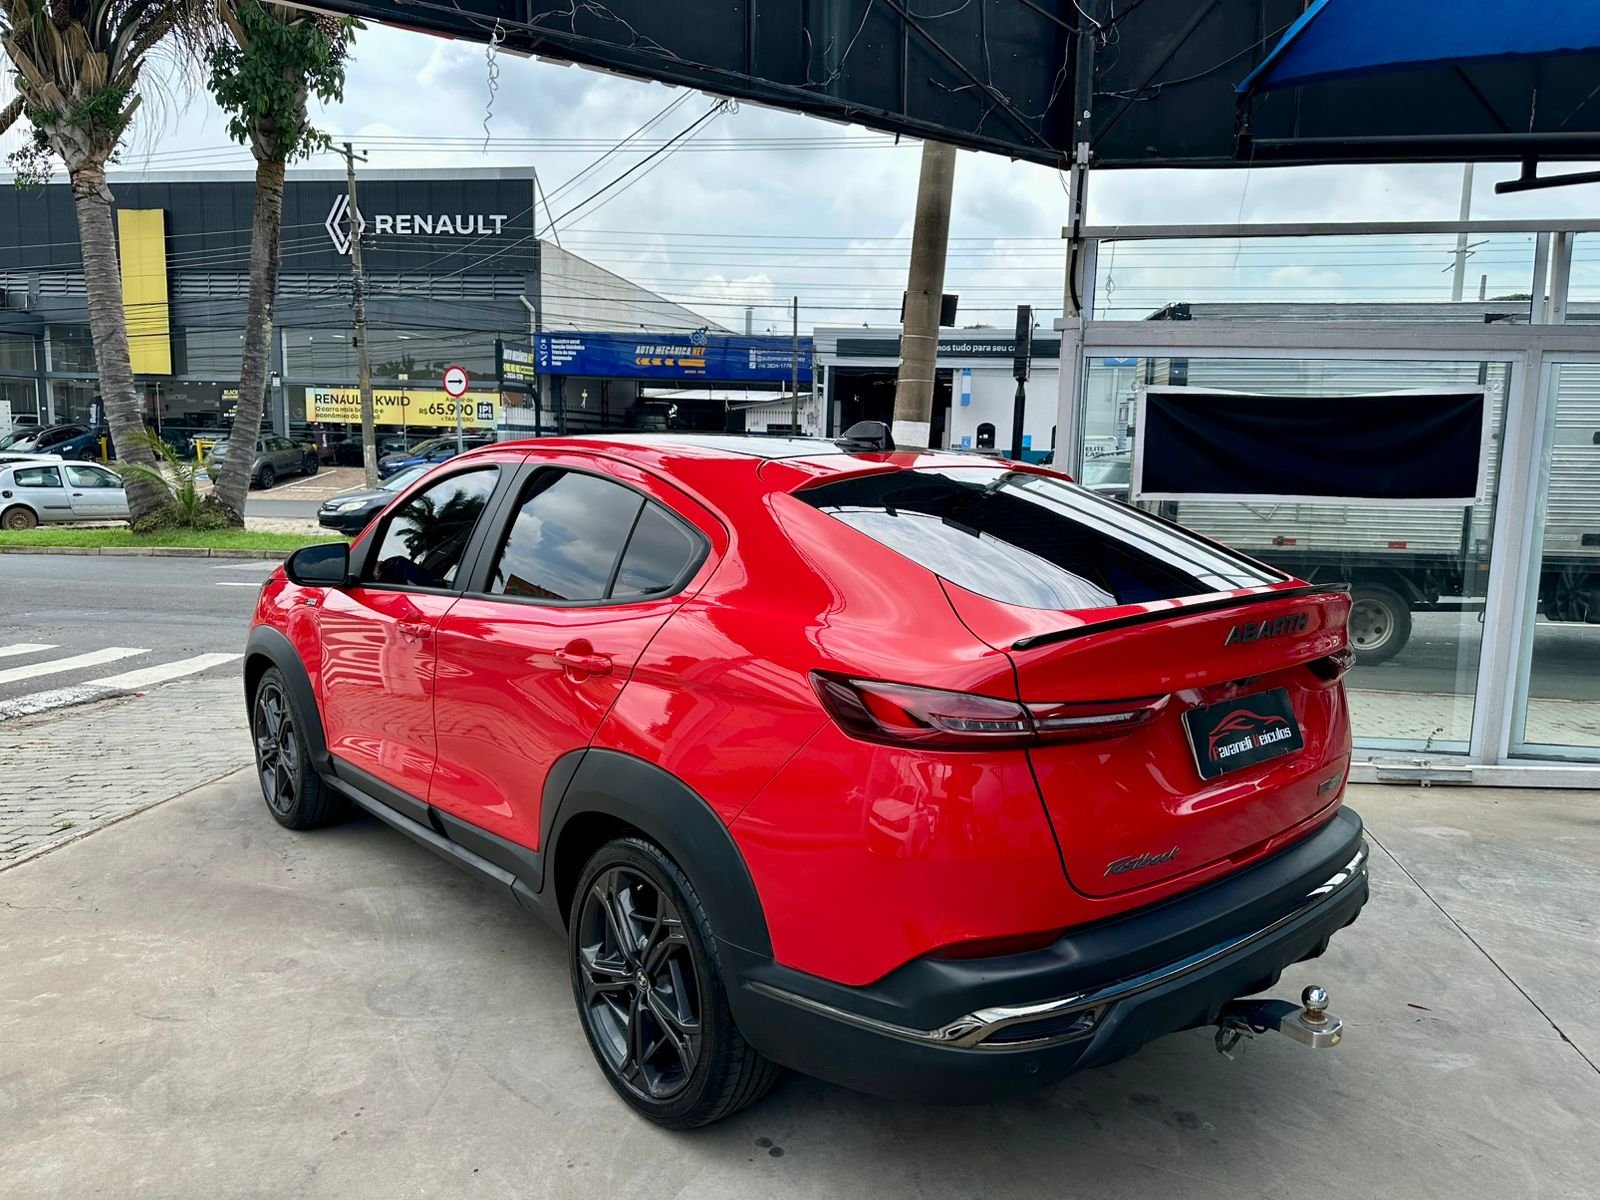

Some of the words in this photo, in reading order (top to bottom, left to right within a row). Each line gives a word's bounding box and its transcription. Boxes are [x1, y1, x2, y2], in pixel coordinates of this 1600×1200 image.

[375, 214, 507, 234] RENAULT
[635, 345, 654, 354] AUTO
[655, 344, 691, 355] MECÂNICA
[315, 394, 361, 405] RENAUL
[375, 396, 410, 406] KWID
[479, 405, 491, 413] IPI
[1224, 612, 1309, 646] ABARTH
